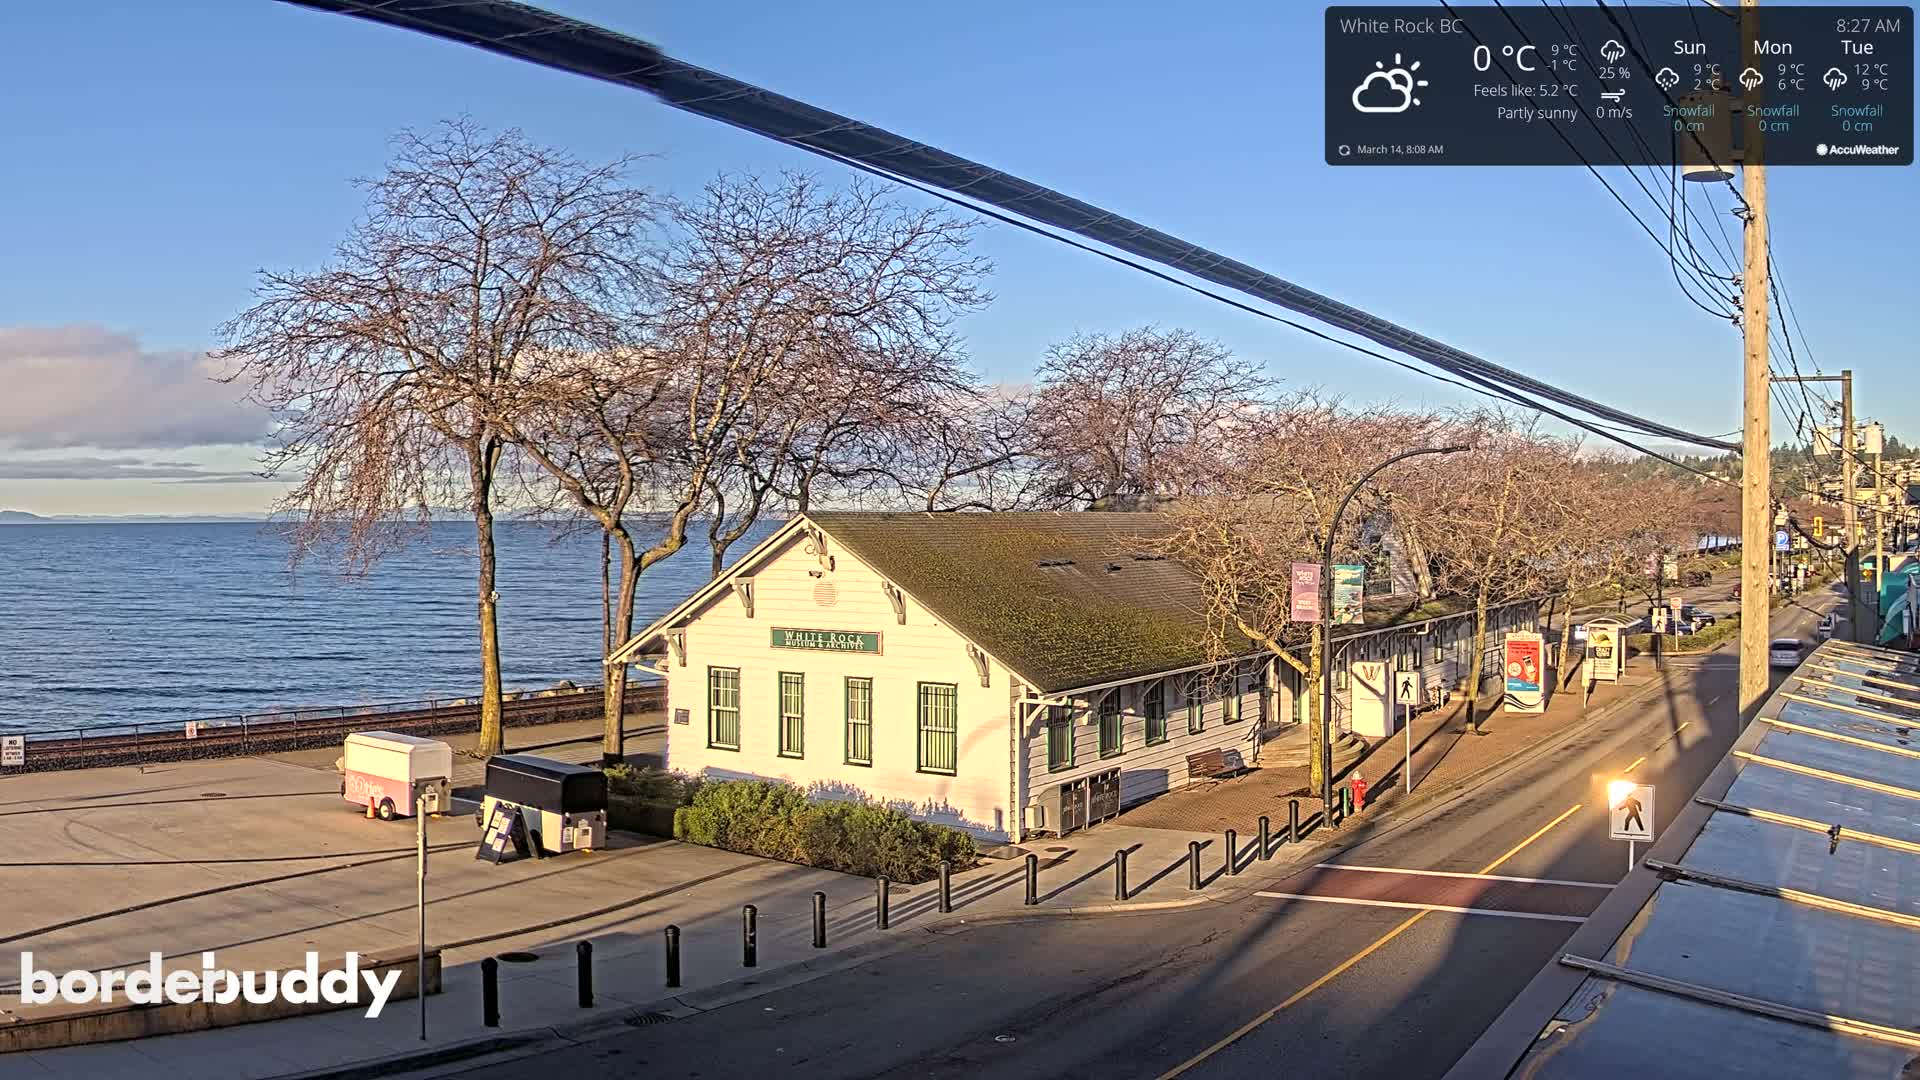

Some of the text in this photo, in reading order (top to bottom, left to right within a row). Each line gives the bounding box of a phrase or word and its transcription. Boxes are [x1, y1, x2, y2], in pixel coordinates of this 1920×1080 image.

[784, 631, 863, 644] WHITE ROCK
[785, 640, 816, 648] MUSEUM
[825, 642, 864, 650] ARCHIVES
